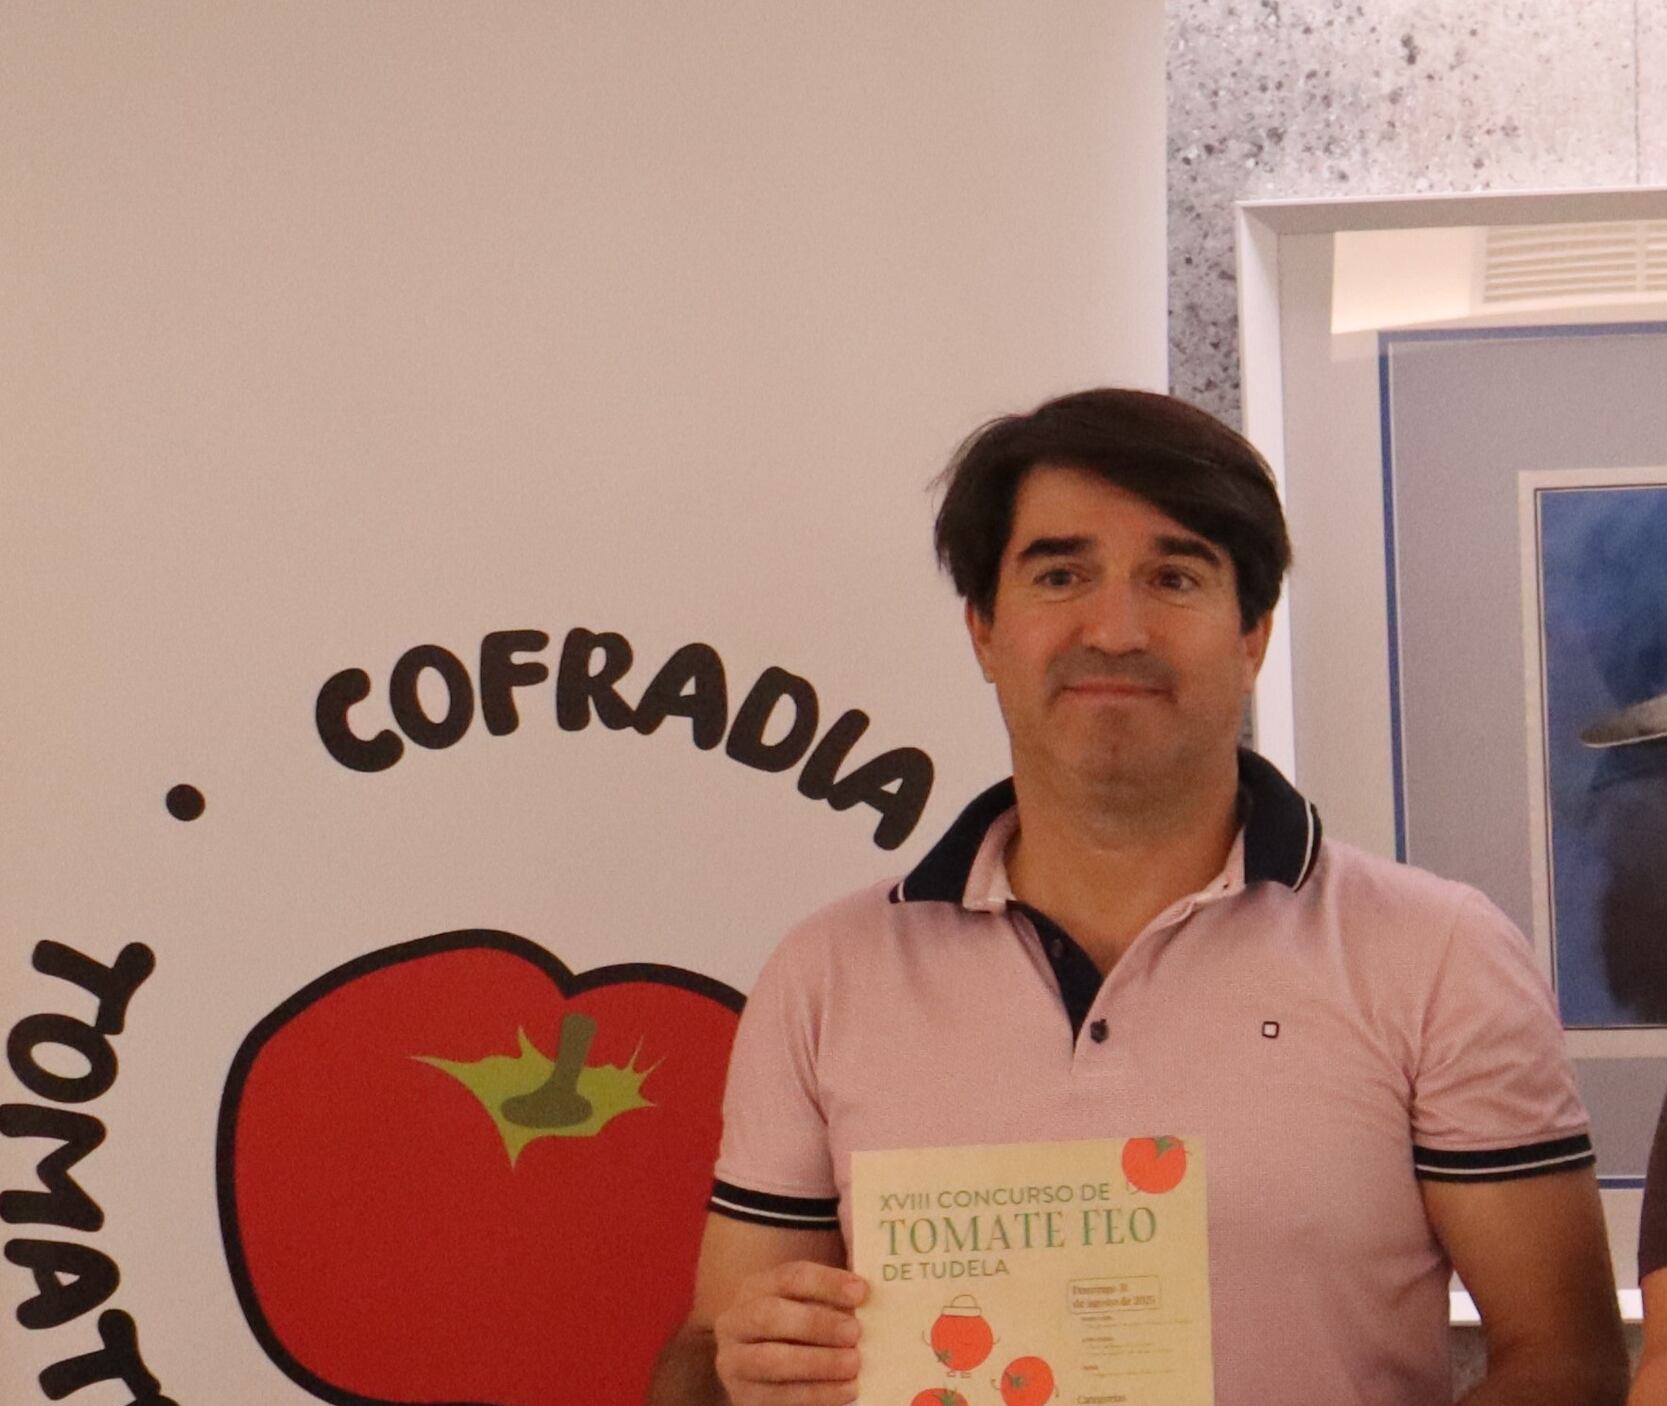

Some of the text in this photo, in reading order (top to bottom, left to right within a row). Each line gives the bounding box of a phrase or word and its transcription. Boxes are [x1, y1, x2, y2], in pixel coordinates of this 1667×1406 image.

[315, 627, 935, 851] COFRADIA
[880, 1182, 1111, 1213] XVIII CONCURSO DE
[880, 1206, 1158, 1257] TOMATE FEO
[882, 1258, 1010, 1282] DE TUDELA
